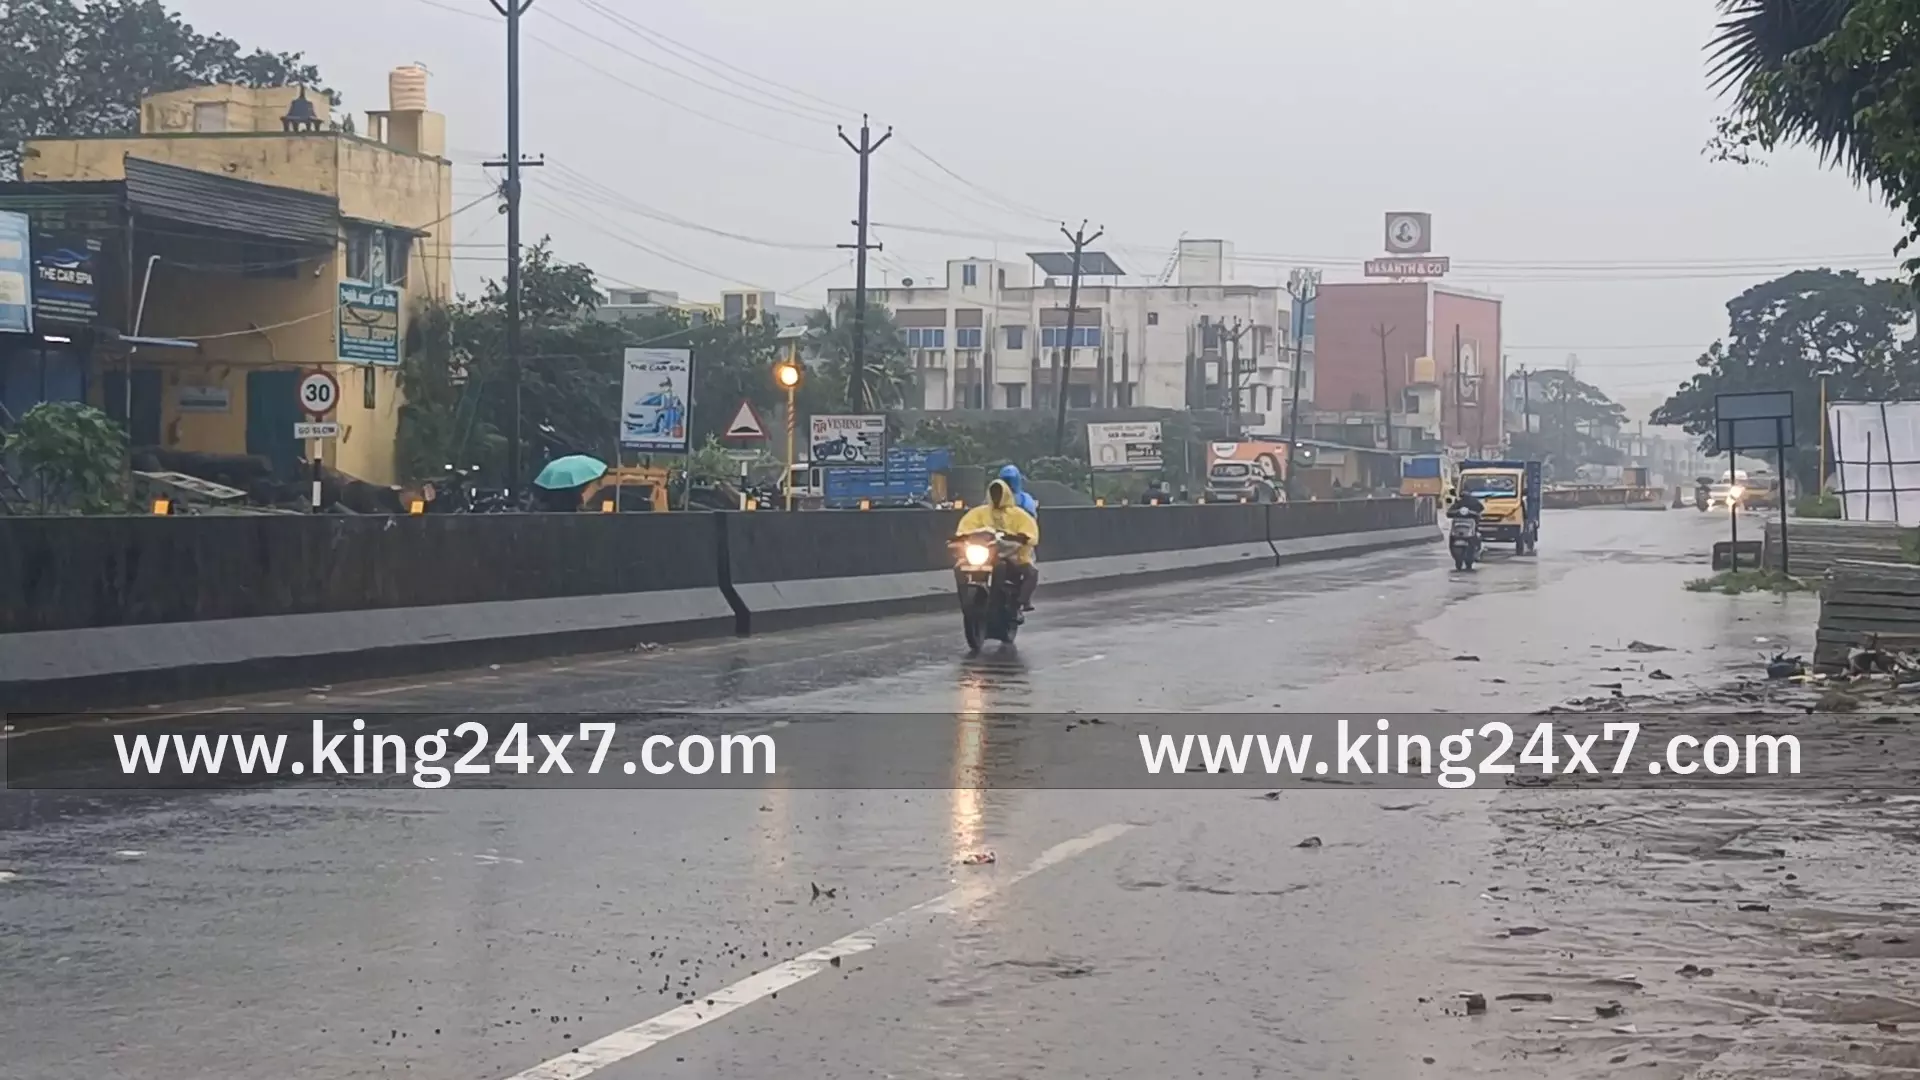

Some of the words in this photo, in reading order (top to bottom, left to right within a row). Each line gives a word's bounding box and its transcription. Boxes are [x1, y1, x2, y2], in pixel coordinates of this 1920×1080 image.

[38, 266, 57, 281] THE
[57, 268, 75, 283] CAR
[75, 271, 94, 285] SPA
[305, 384, 330, 402] 30
